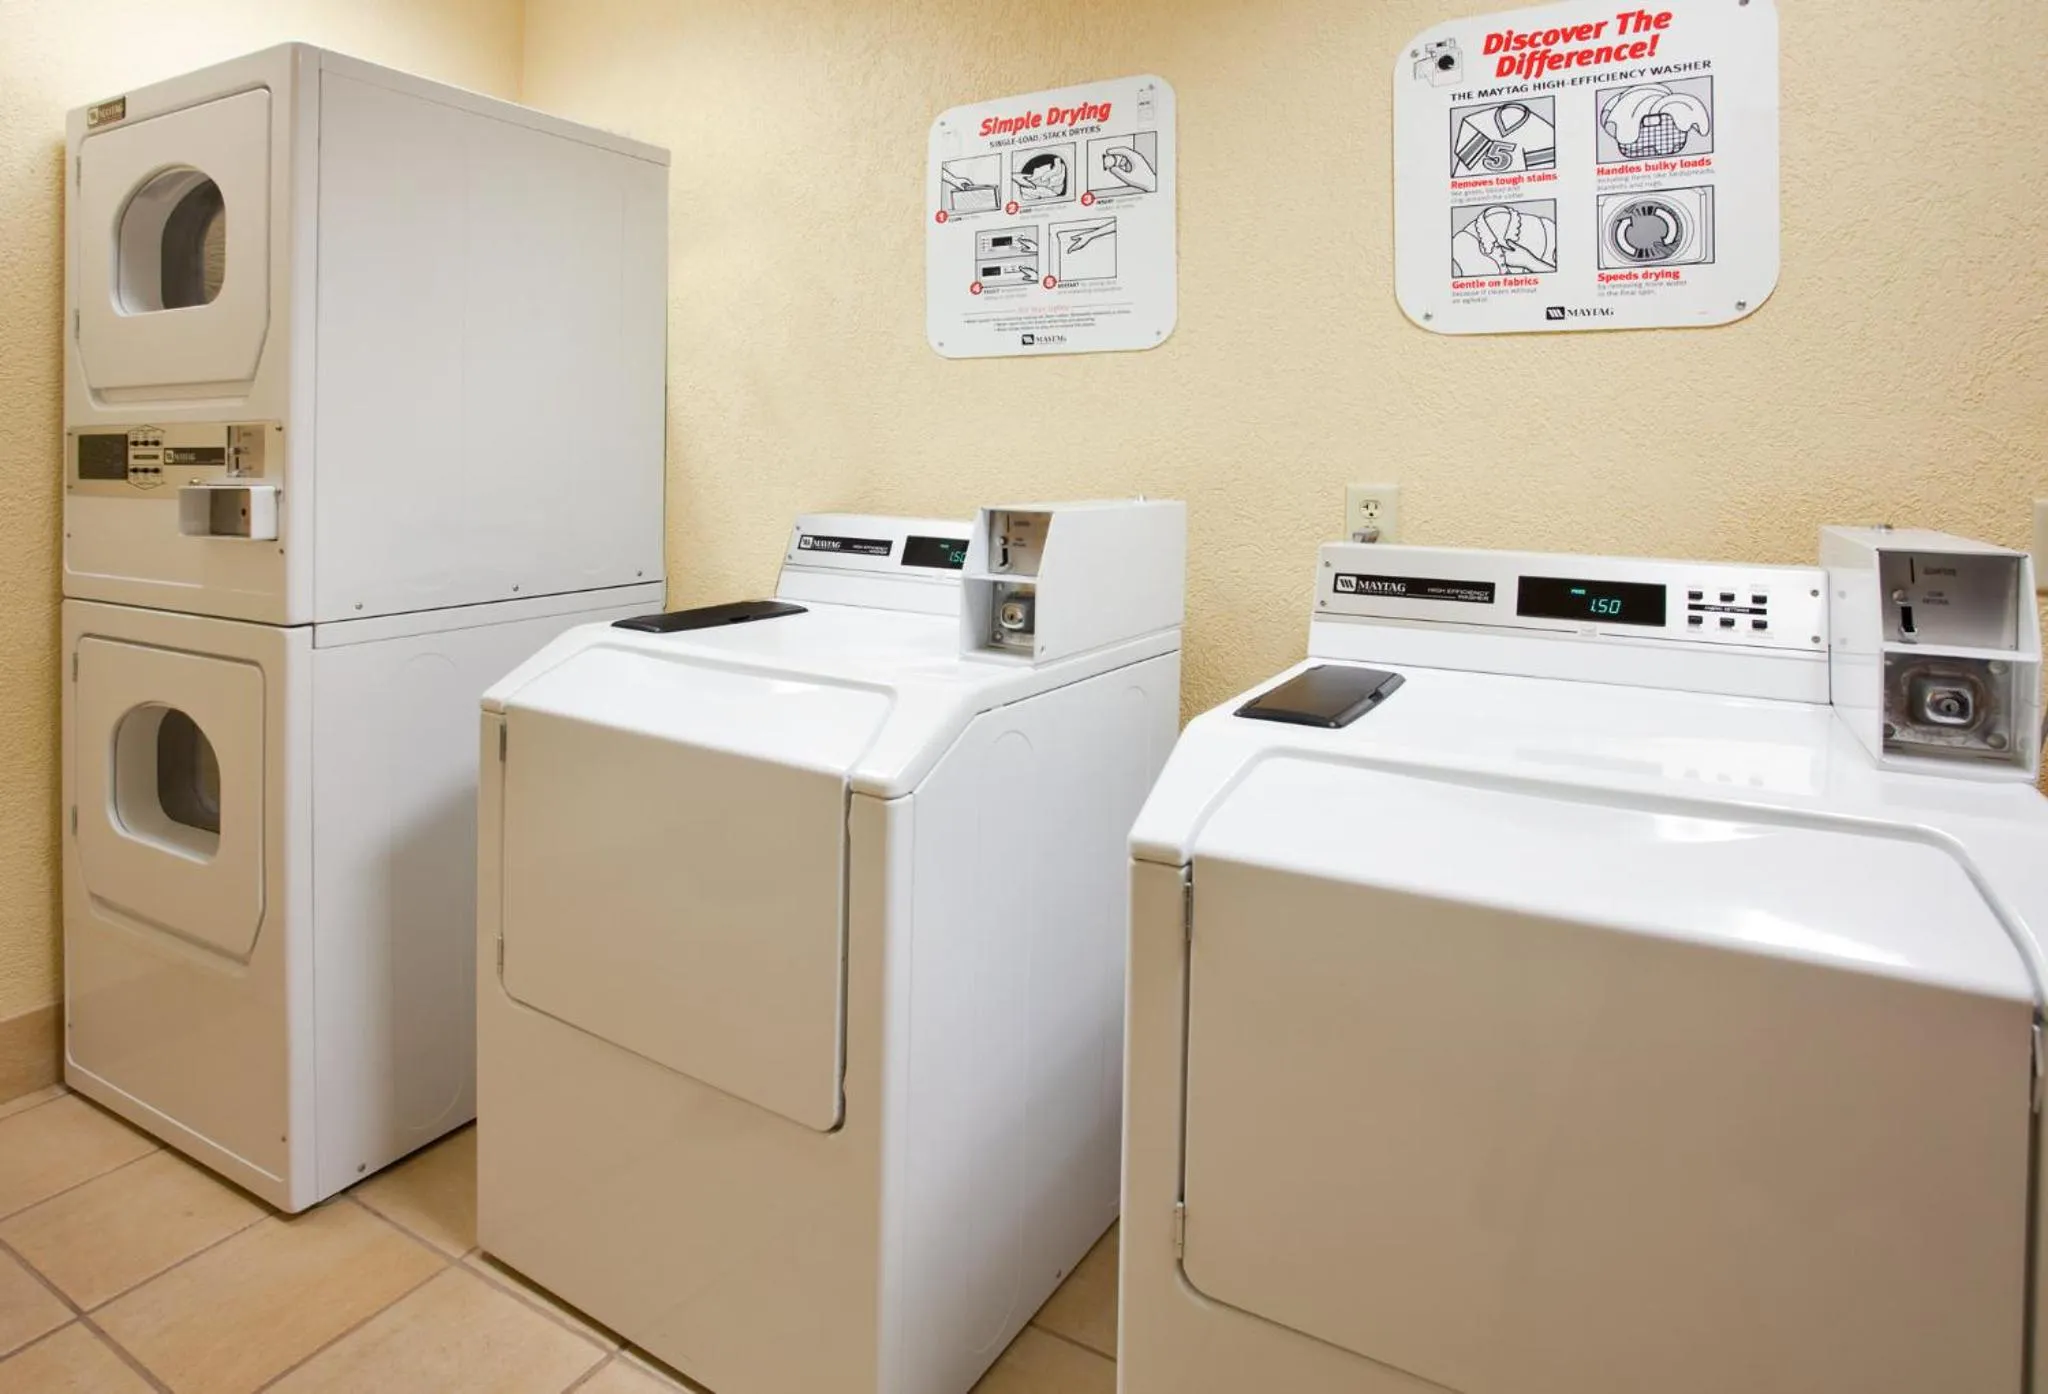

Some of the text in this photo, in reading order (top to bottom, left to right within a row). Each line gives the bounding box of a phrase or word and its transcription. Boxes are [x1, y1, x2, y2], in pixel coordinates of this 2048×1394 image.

[1483, 9, 1673, 56] Discover The
[1495, 34, 1660, 79] Difference!
[1451, 60, 1713, 101] THE MAYTAG HIGH-EFFICIENCY WASHER
[979, 101, 1112, 137] Simple Drying
[1069, 125, 1102, 137] DRYERS
[1597, 157, 1712, 176] Handles bulky loads
[1451, 172, 1558, 189] Removes tough stains
[1452, 276, 1539, 289] Gentle on fabrics
[1597, 268, 1680, 283] Speeds drying
[1567, 307, 1615, 318] MAYTAG
[1359, 580, 1407, 592] MAYTAG
